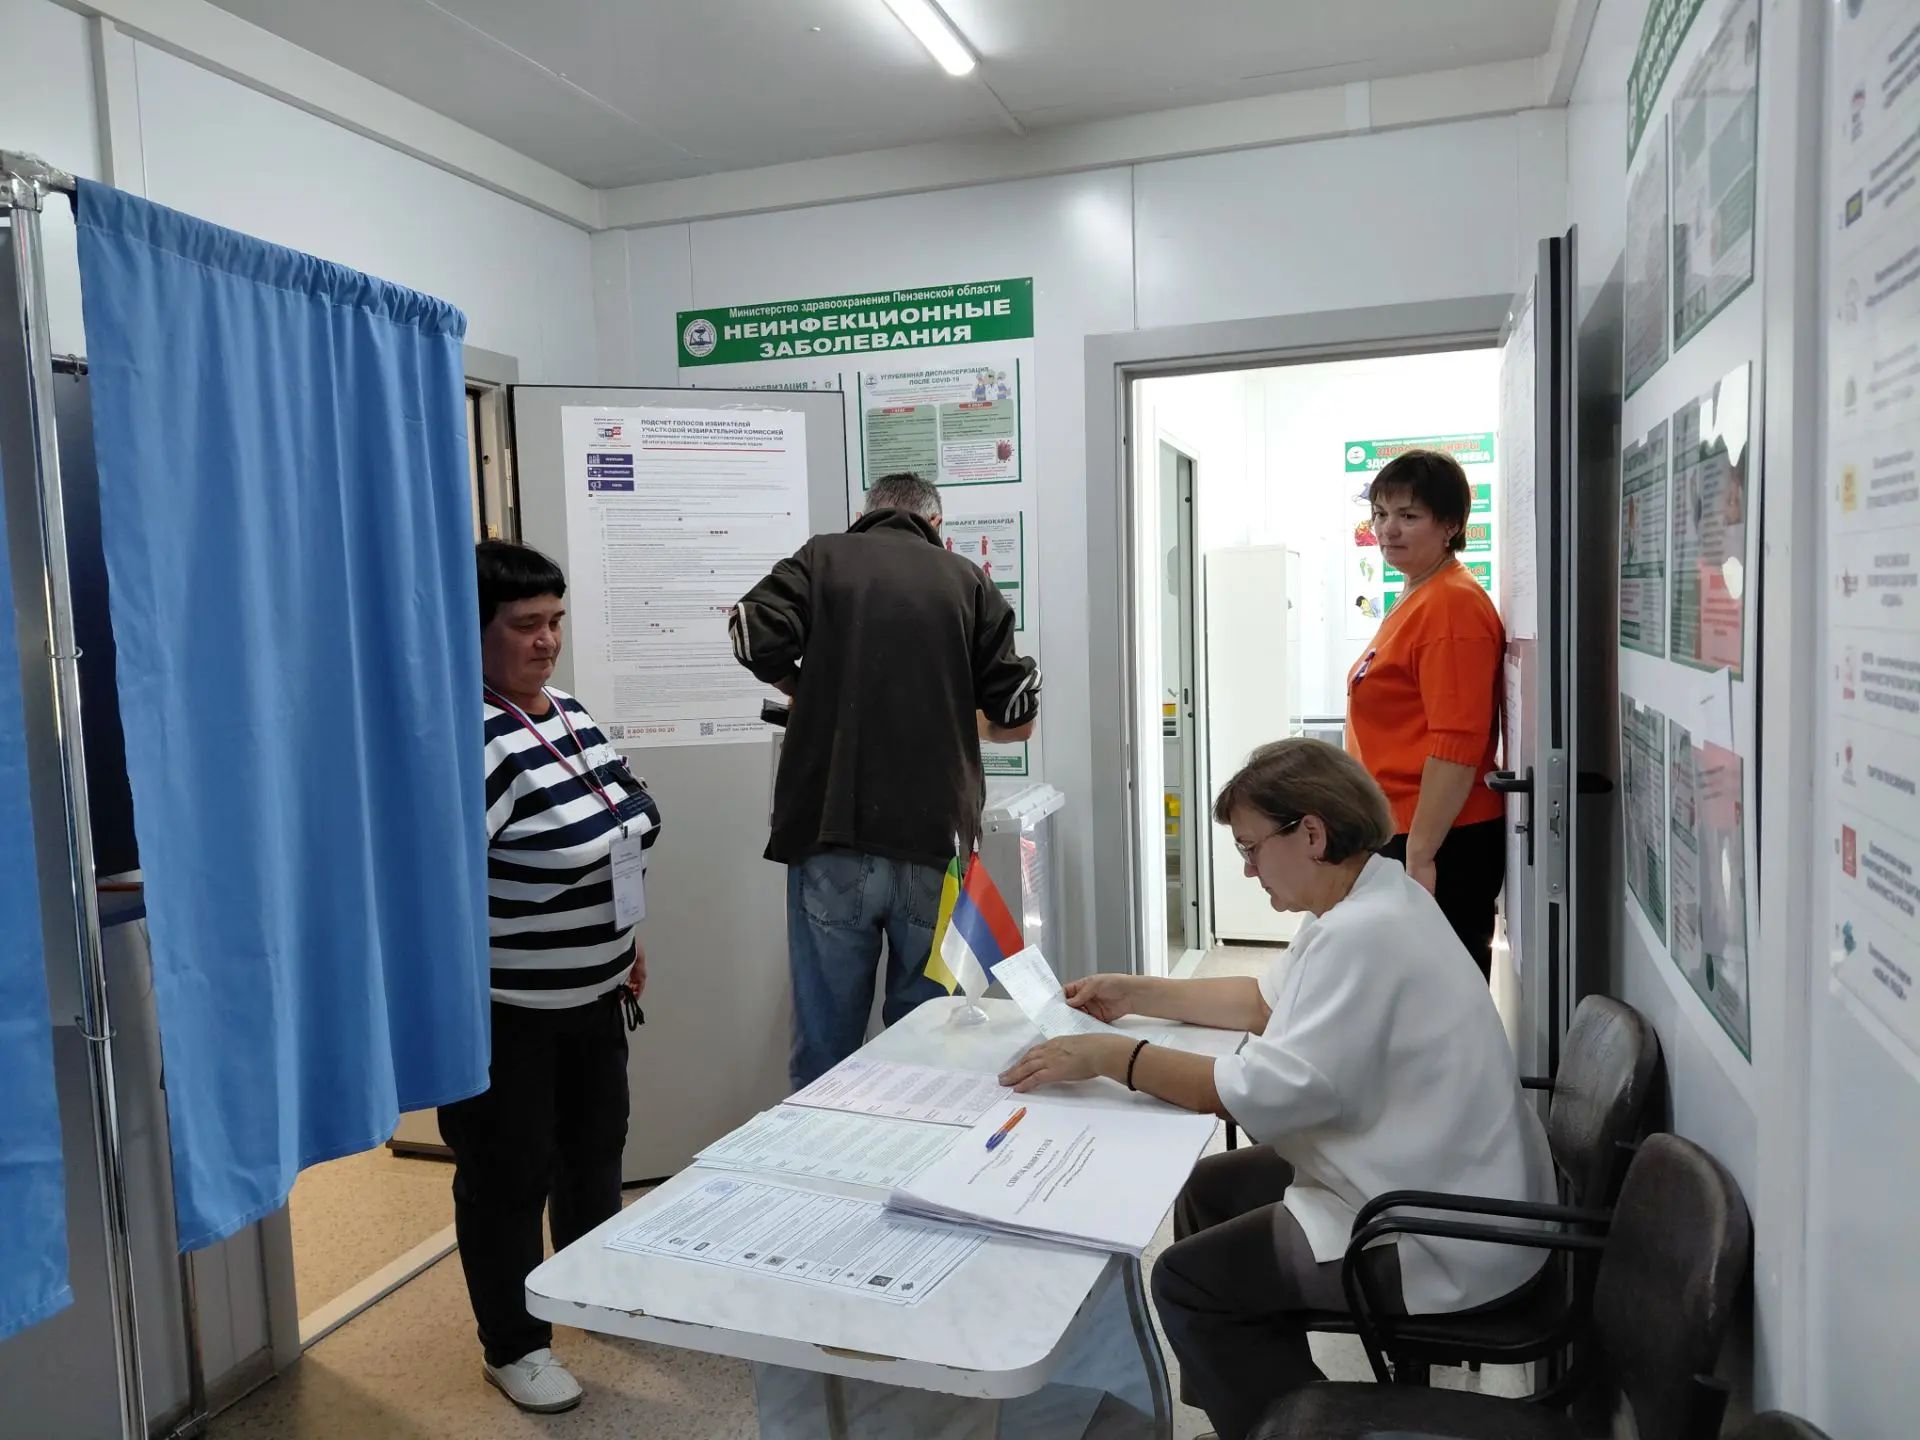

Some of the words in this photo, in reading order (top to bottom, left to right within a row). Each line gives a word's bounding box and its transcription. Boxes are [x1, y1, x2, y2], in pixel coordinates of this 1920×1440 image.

[729, 304, 798, 318] Министерство
[801, 295, 890, 312] здравоохранения
[893, 286, 954, 303] Пензенской
[957, 284, 1001, 296] области
[724, 299, 1011, 340] НЕИНФЕКЦИОННЫЕ
[759, 325, 972, 358] ЗАБОЛЕВАНИЯ
[705, 420, 751, 428] ИЗБИРАТЕЛЕЙ
